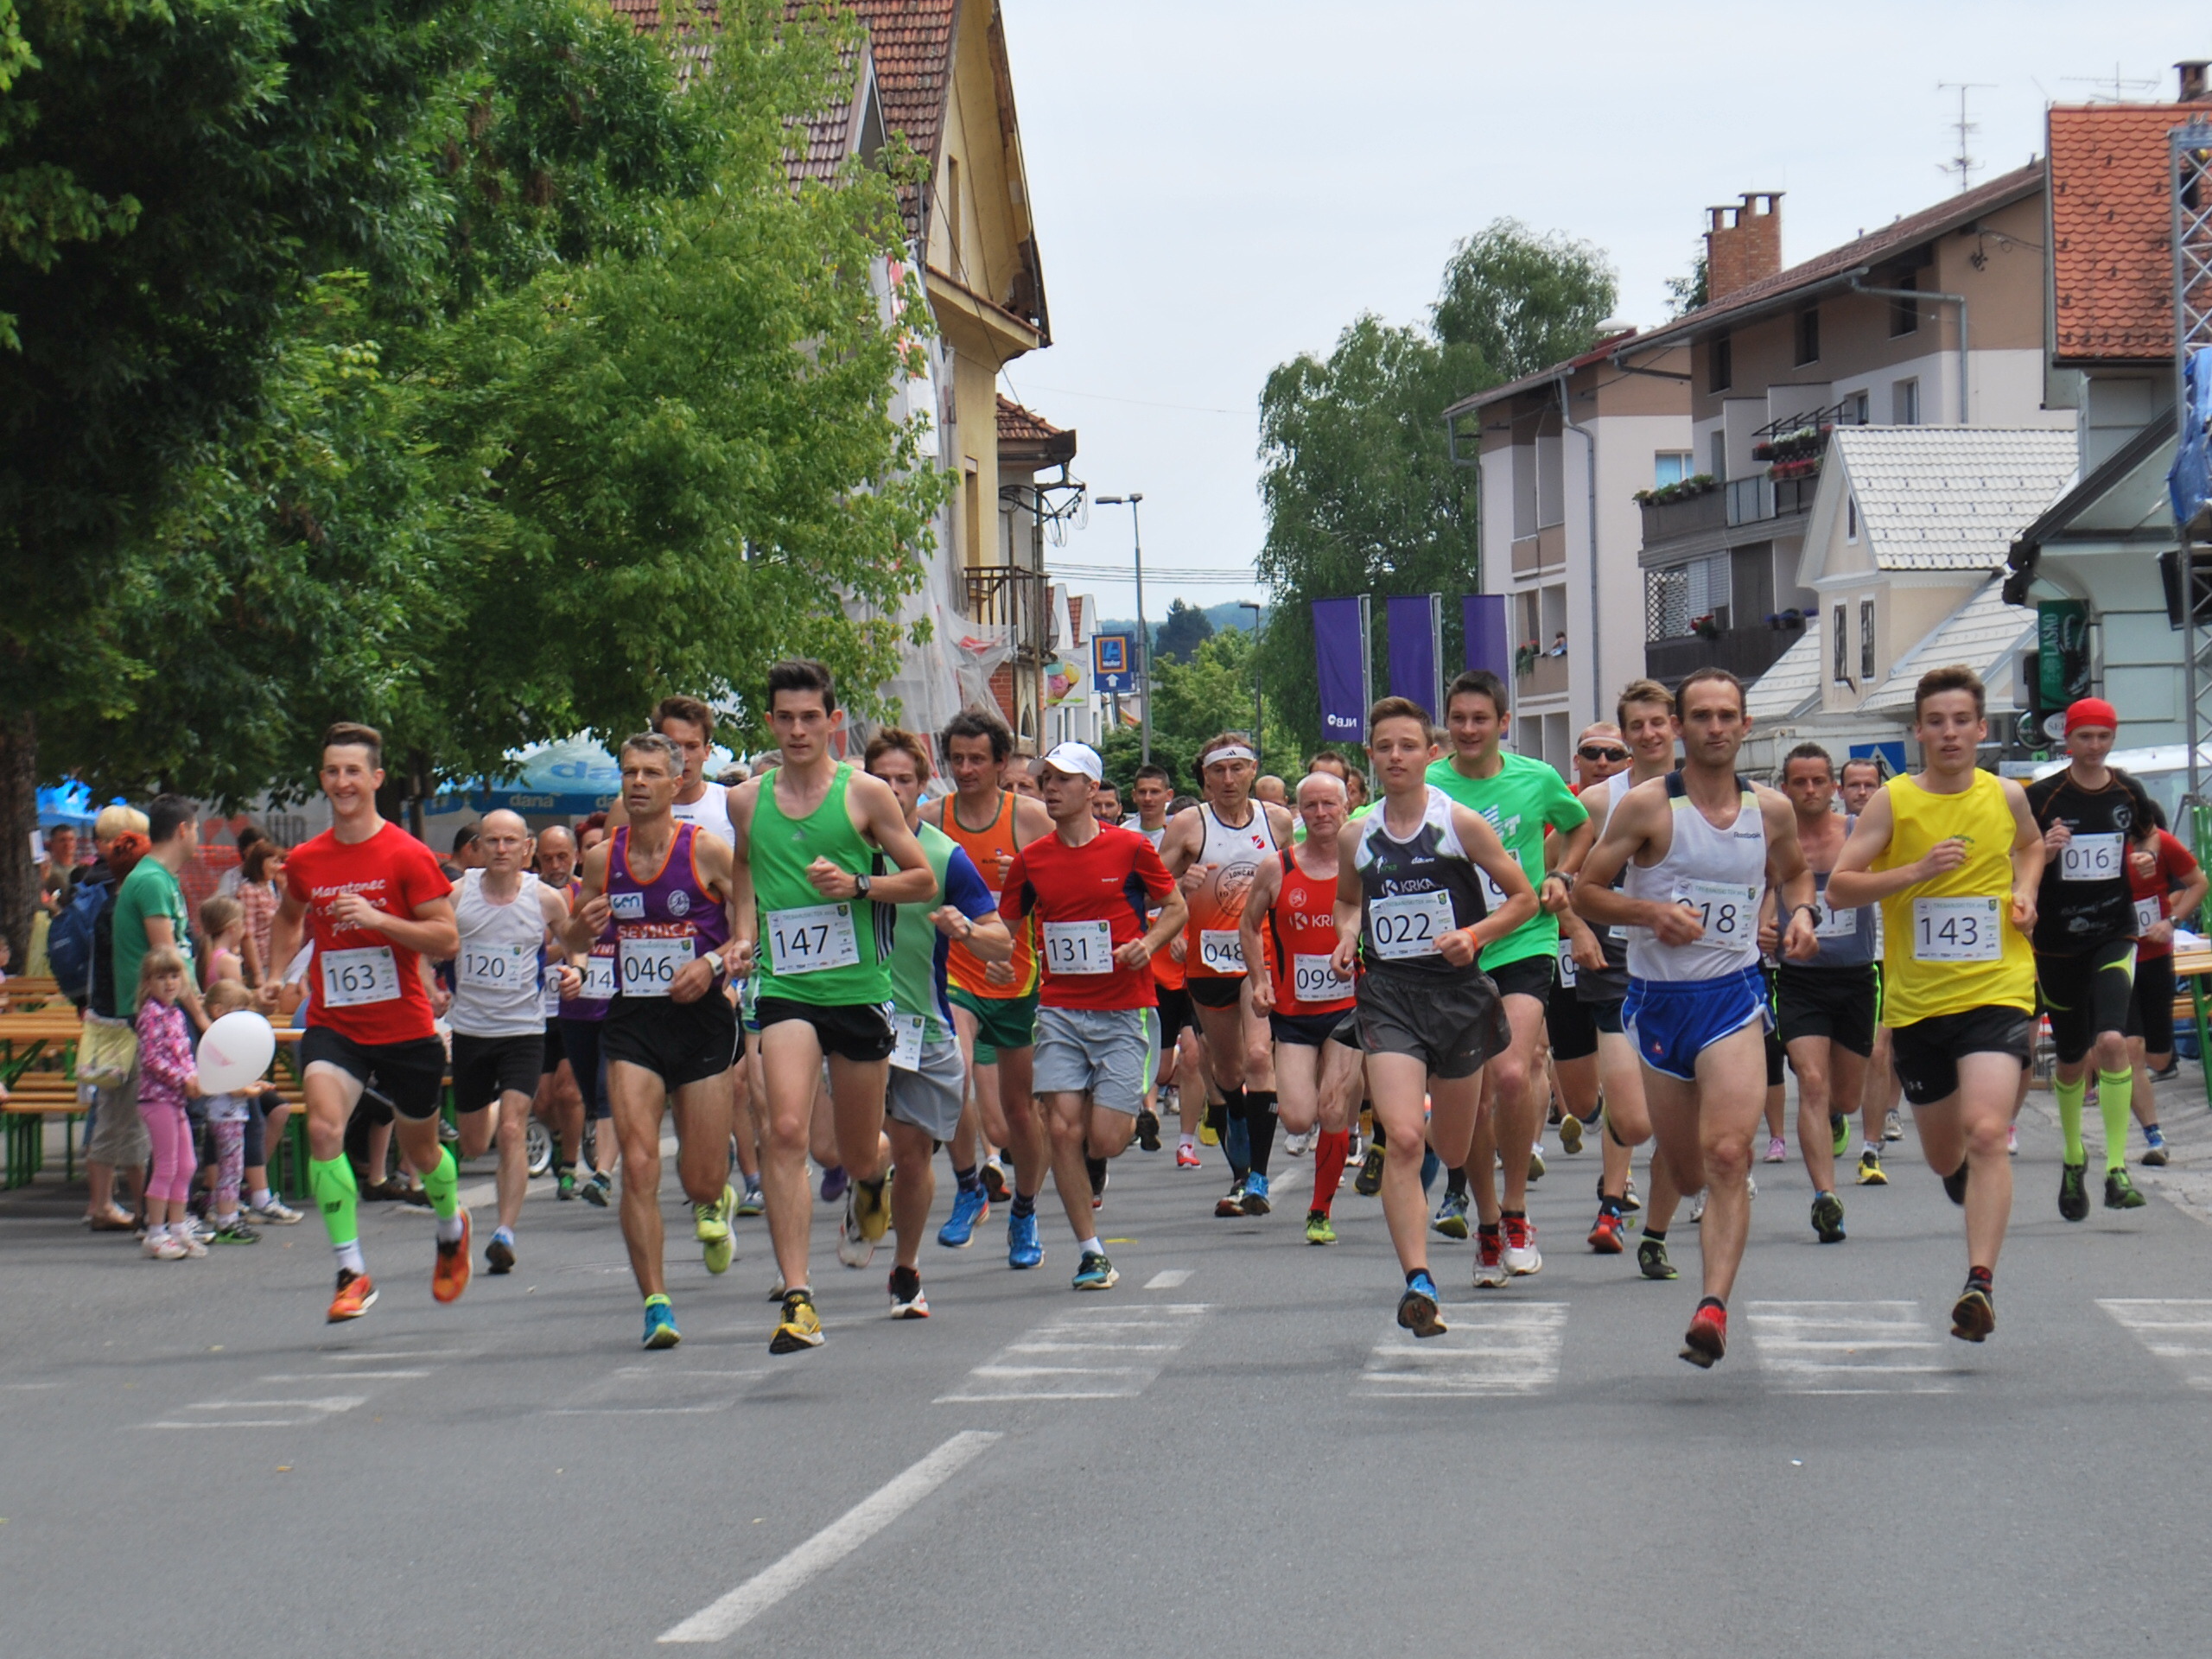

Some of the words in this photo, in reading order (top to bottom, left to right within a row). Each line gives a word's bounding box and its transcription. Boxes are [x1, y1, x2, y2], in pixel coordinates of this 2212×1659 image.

[509, 794, 555, 808] dana
[2065, 848, 2109, 869] 016
[1400, 878, 1436, 893] KRKA
[617, 921, 698, 939] SEVNICA
[1376, 912, 1433, 944] 022
[1920, 917, 1979, 946] 143
[775, 925, 829, 958] 147
[1048, 938, 1088, 962] 131
[1204, 943, 1244, 963] 048
[465, 953, 505, 978] 120
[625, 956, 674, 982] 046
[328, 964, 376, 993] 163
[1297, 968, 1338, 990] 099
